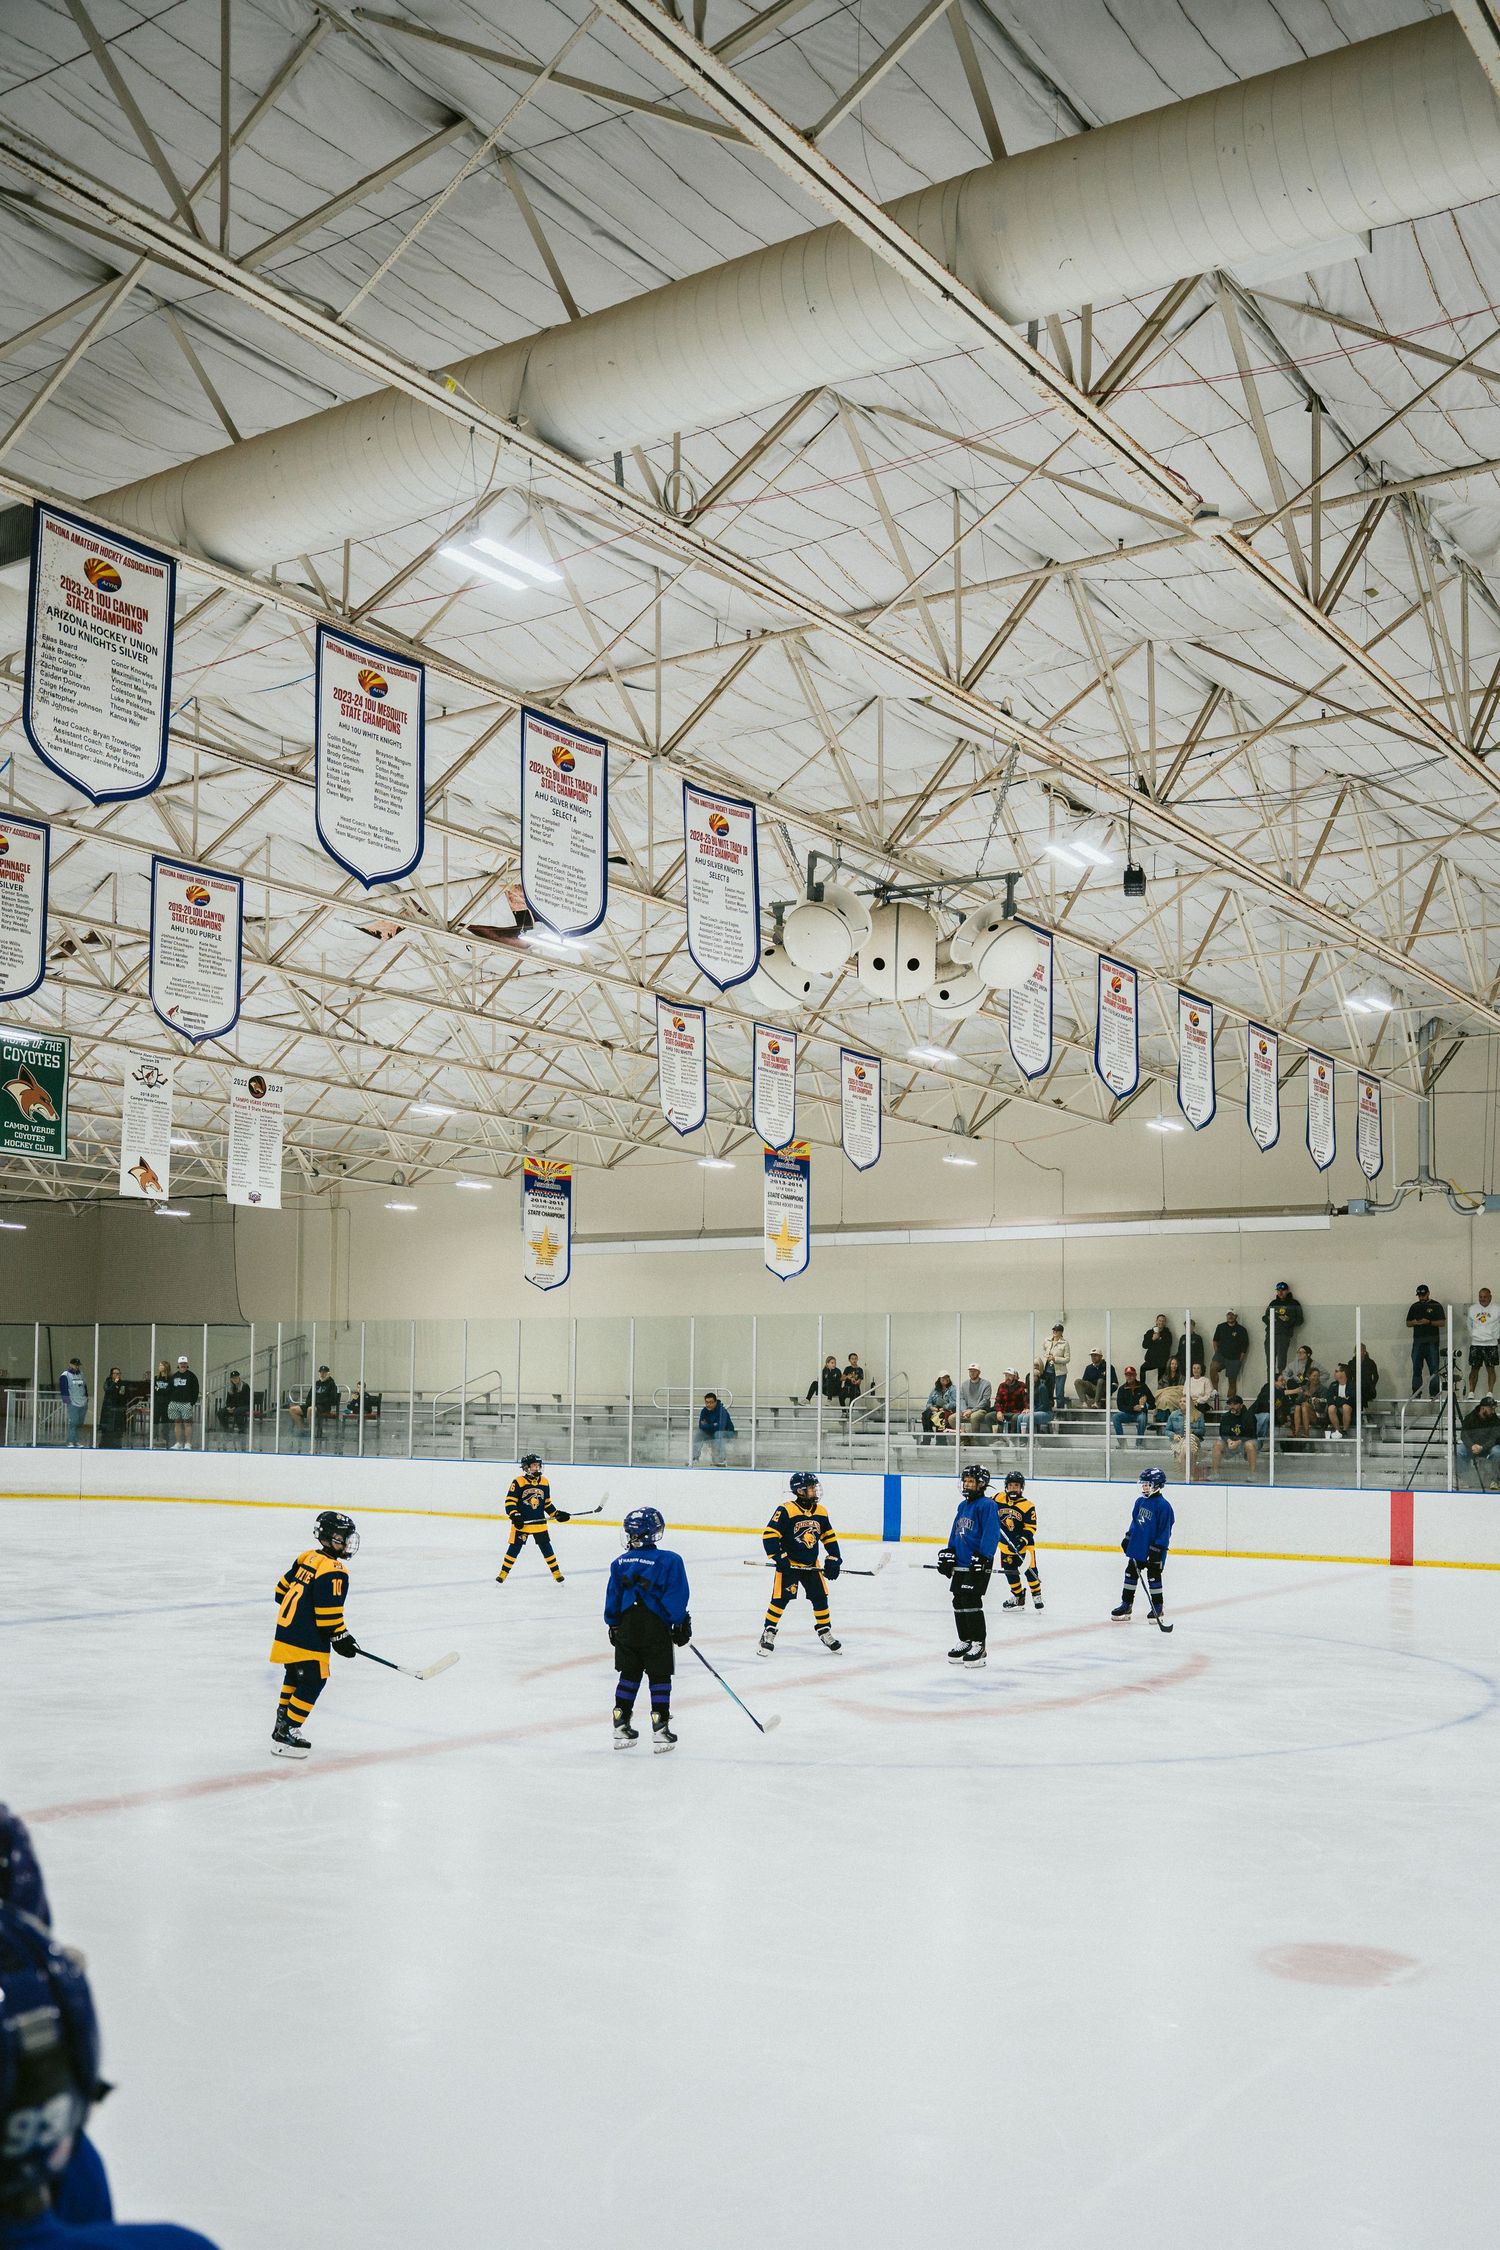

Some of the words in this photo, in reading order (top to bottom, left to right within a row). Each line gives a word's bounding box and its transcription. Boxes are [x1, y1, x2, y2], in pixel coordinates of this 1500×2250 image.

[46, 521, 69, 539] ARIZONA
[70, 533, 99, 552] AMATEUR
[100, 546, 122, 564] HOCKEY
[123, 556, 163, 578] ASSOCIATION
[61, 576, 93, 600] 2023-24
[96, 592, 110, 609] 10U
[113, 598, 148, 622] CANYON
[66, 594, 89, 614] STATE
[91, 604, 142, 634] CHAMPIONS
[47, 606, 88, 629] ARIZONA
[90, 623, 127, 643] HOCKEY
[130, 638, 158, 656] UNION
[58, 622, 75, 636] 10U
[78, 629, 116, 652] KNIGHTS
[120, 648, 148, 664] SILVER
[59, 639, 77, 651] Beard
[58, 657, 76, 669] Colon
[59, 685, 77, 698] Henry
[111, 694, 124, 704] Luke
[77, 699, 102, 714] Johnson
[111, 702, 132, 715] Thomas
[334, 687, 362, 708] 2023-24
[364, 697, 376, 712] 10U
[377, 704, 407, 724] MESQUITE
[54, 716, 68, 726] Head
[341, 704, 360, 721] STATE
[362, 712, 400, 735] CHAMPIONS
[54, 726, 83, 741] Assistant
[351, 726, 361, 735] 10U
[363, 730, 378, 741] WHITE
[380, 736, 402, 749] KNIGHTS
[47, 741, 63, 752] Team
[55, 735, 82, 750] Assistant
[529, 760, 552, 779] 2024-25
[575, 778, 592, 794] TRACK
[541, 777, 556, 792] STATE
[557, 782, 589, 805] CHAMPIONS
[535, 789, 548, 802] AHU
[550, 795, 568, 809] SILVER
[570, 803, 591, 818] KNIGHTS
[552, 808, 572, 822] SELECT
[573, 816, 577, 824] A
[13, 827, 40, 842] ASSOCIATION
[700, 844, 714, 856] STATE
[1, 857, 30, 874] PINNACLE
[707, 860, 723, 871] SILVER
[724, 865, 743, 876] KNIGHTS
[709, 871, 725, 882] SELECT
[0, 880, 23, 892] SILVER
[172, 912, 188, 924] STATE
[189, 916, 221, 931] CHAMPIONS
[193, 907, 202, 918] 10U
[204, 910, 225, 923] CANYON
[171, 924, 184, 933] AHU
[186, 928, 198, 936] 10U
[199, 930, 221, 941] PURPLE
[33, 1039, 42, 1049] OF
[46, 1041, 62, 1052] THE
[3, 1046, 60, 1069] COYOTES
[234, 1078, 247, 1087] 2022
[268, 1084, 283, 1093] 2023
[4, 1121, 29, 1131] CAMPO
[31, 1125, 55, 1135] VERDE
[15, 1132, 45, 1142] COYOTES
[4, 1139, 33, 1149] HOCKEY
[35, 1143, 54, 1152] CLUB
[768, 1169, 804, 1182] ARIZONA
[528, 1189, 565, 1200] ARIZONA
[528, 1209, 540, 1217] STATE
[542, 1211, 565, 1219] CHAMPIONS
[331, 1578, 343, 1596] 10
